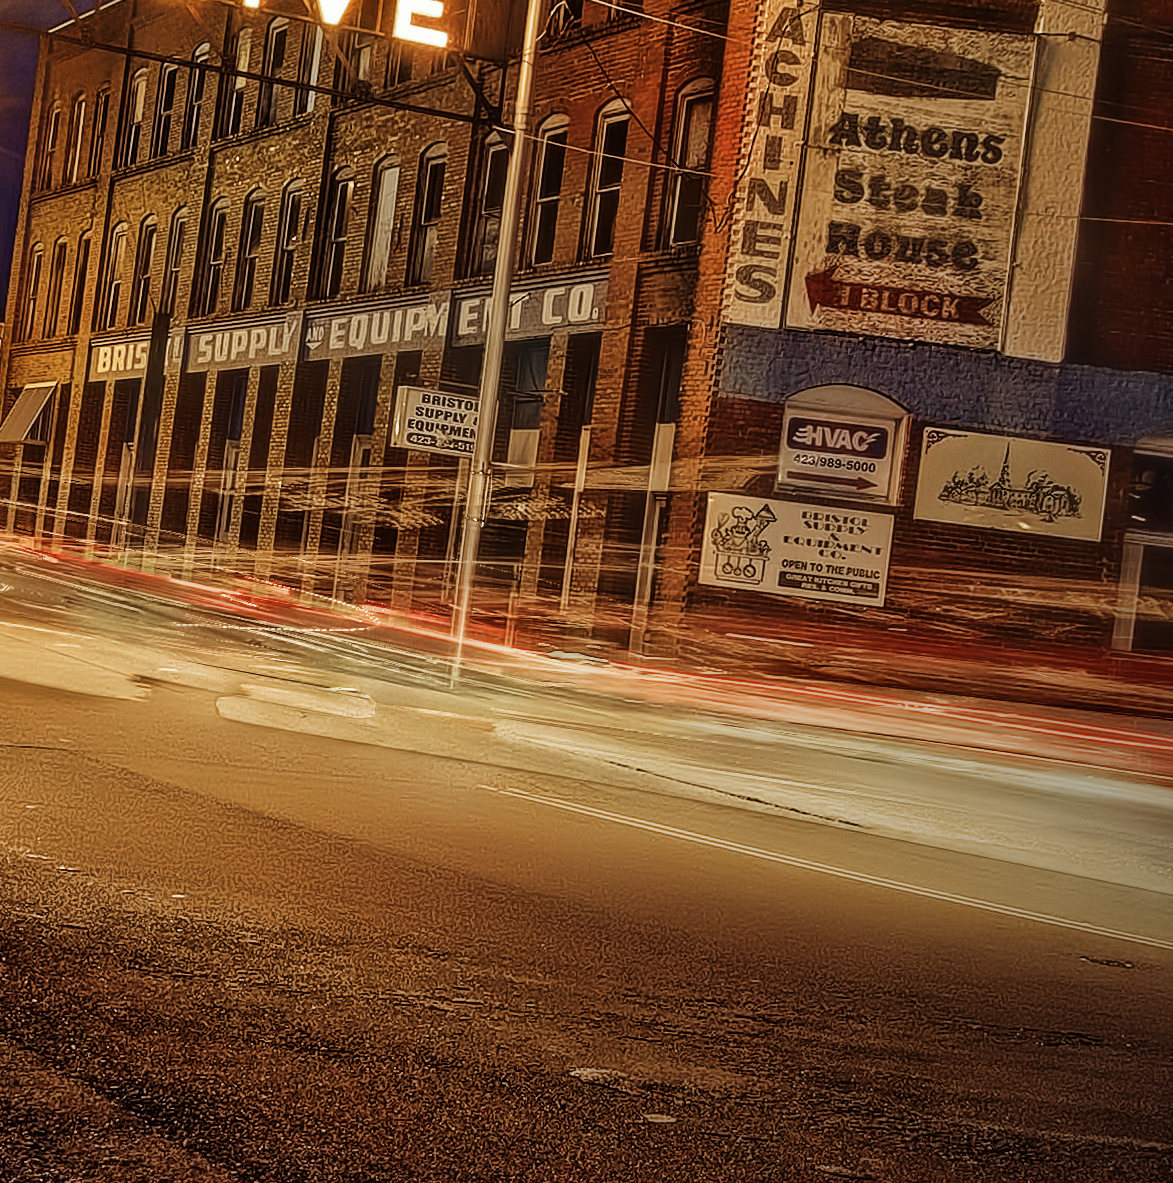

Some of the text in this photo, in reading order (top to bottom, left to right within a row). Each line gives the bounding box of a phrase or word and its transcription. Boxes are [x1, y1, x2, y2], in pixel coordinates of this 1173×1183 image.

[830, 112, 1006, 164] Athens
[833, 170, 984, 219] Steak
[827, 220, 979, 268] House
[860, 287, 959, 319] BLOCK
[197, 318, 298, 364] SUPPLY
[305, 323, 325, 343] AND
[541, 283, 599, 326] CO.
[415, 406, 468, 424] SUPPLY
[407, 418, 476, 439] EQUIPMEN
[803, 424, 869, 452] HVAC
[793, 453, 876, 473] 423/989-5000
[801, 510, 869, 527] BRISTOL
[803, 520, 868, 535] SUPPLY
[783, 535, 883, 555] EQUIPMENT
[818, 549, 847, 560] CO.
[781, 558, 881, 580] OPEN TO THE PUBLIC
